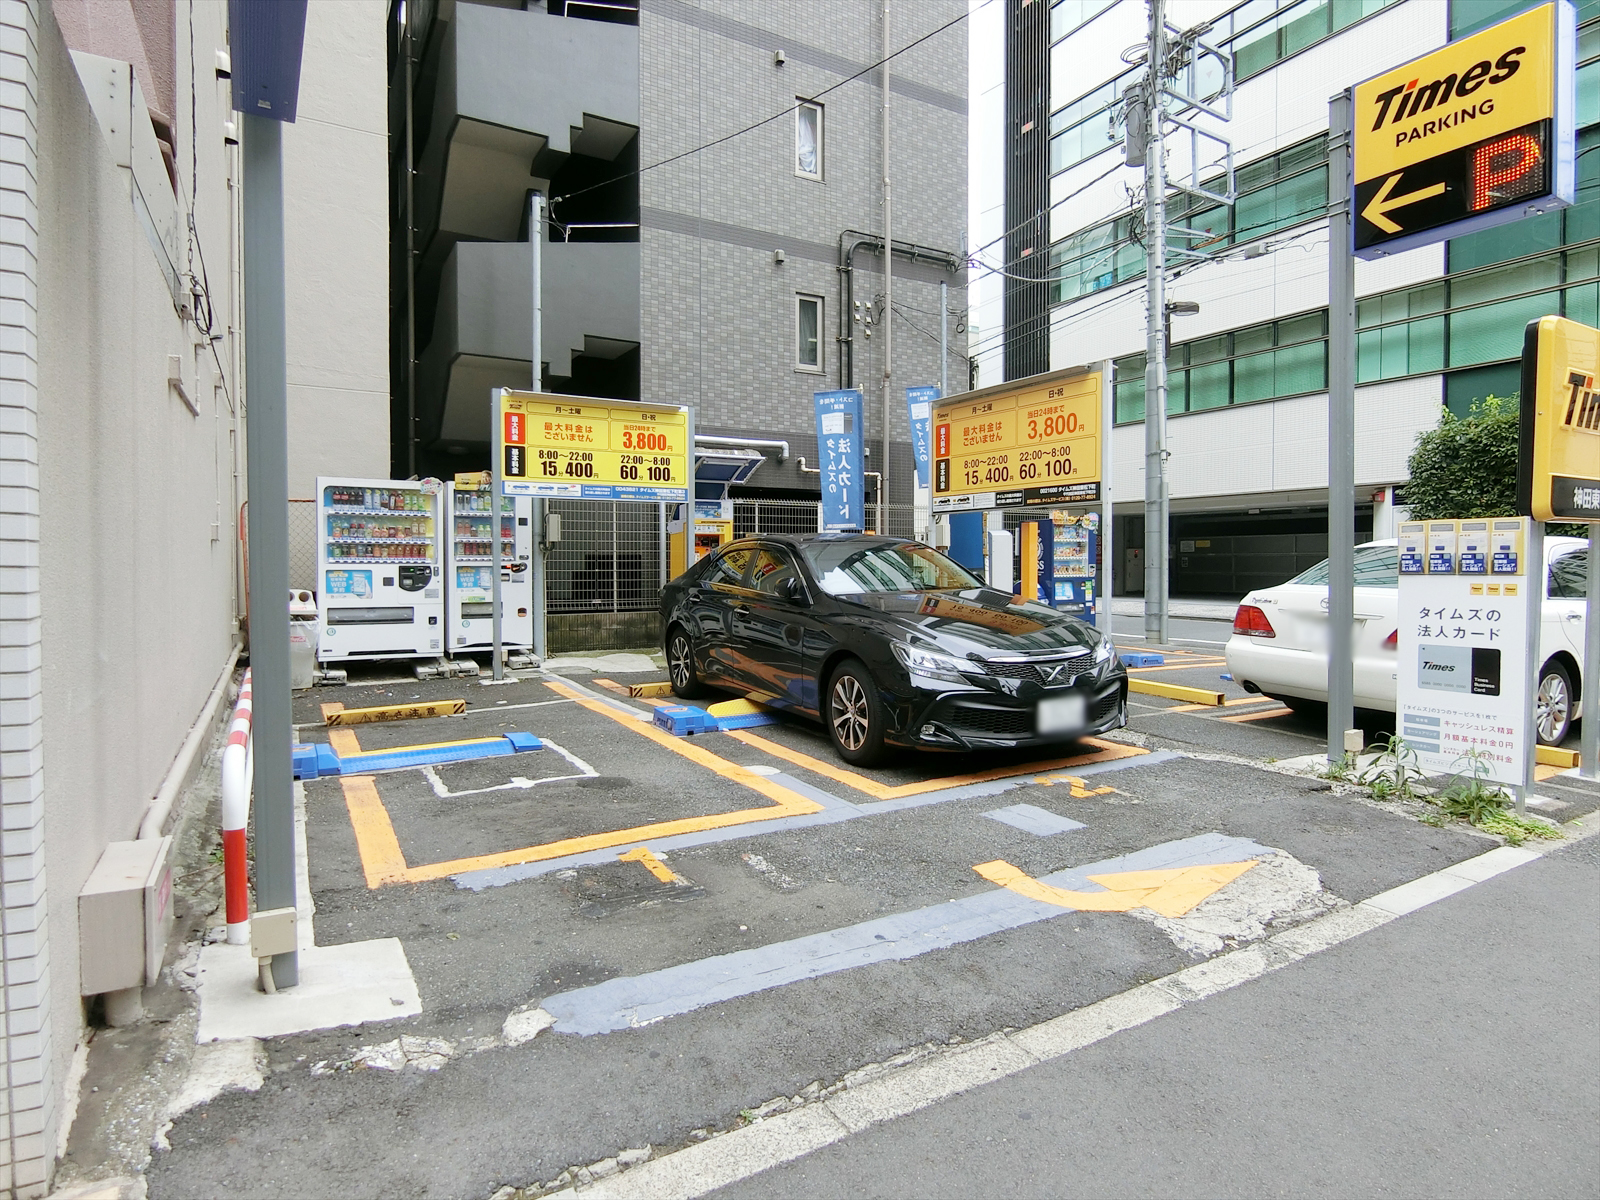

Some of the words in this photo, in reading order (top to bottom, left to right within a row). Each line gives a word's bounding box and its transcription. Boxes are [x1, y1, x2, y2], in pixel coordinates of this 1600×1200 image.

[1371, 46, 1526, 133] Times
[1396, 99, 1494, 147] PARKING
[1472, 133, 1540, 211] P
[1027, 405, 1065, 419] 当日24時まで
[544, 422, 593, 433] 最大料金は
[963, 421, 1002, 437] 最大料金は
[544, 432, 593, 442] ございません
[963, 433, 1002, 447] ございません
[1419, 607, 1501, 622] タイムズの
[1418, 625, 1501, 641] 法人カード
[1422, 661, 1456, 672] Times
[377, 707, 436, 720] 高さ注意
[1444, 720, 1514, 735] キャッシュレス精算
[1444, 733, 1514, 749] 月額基本料金0円
